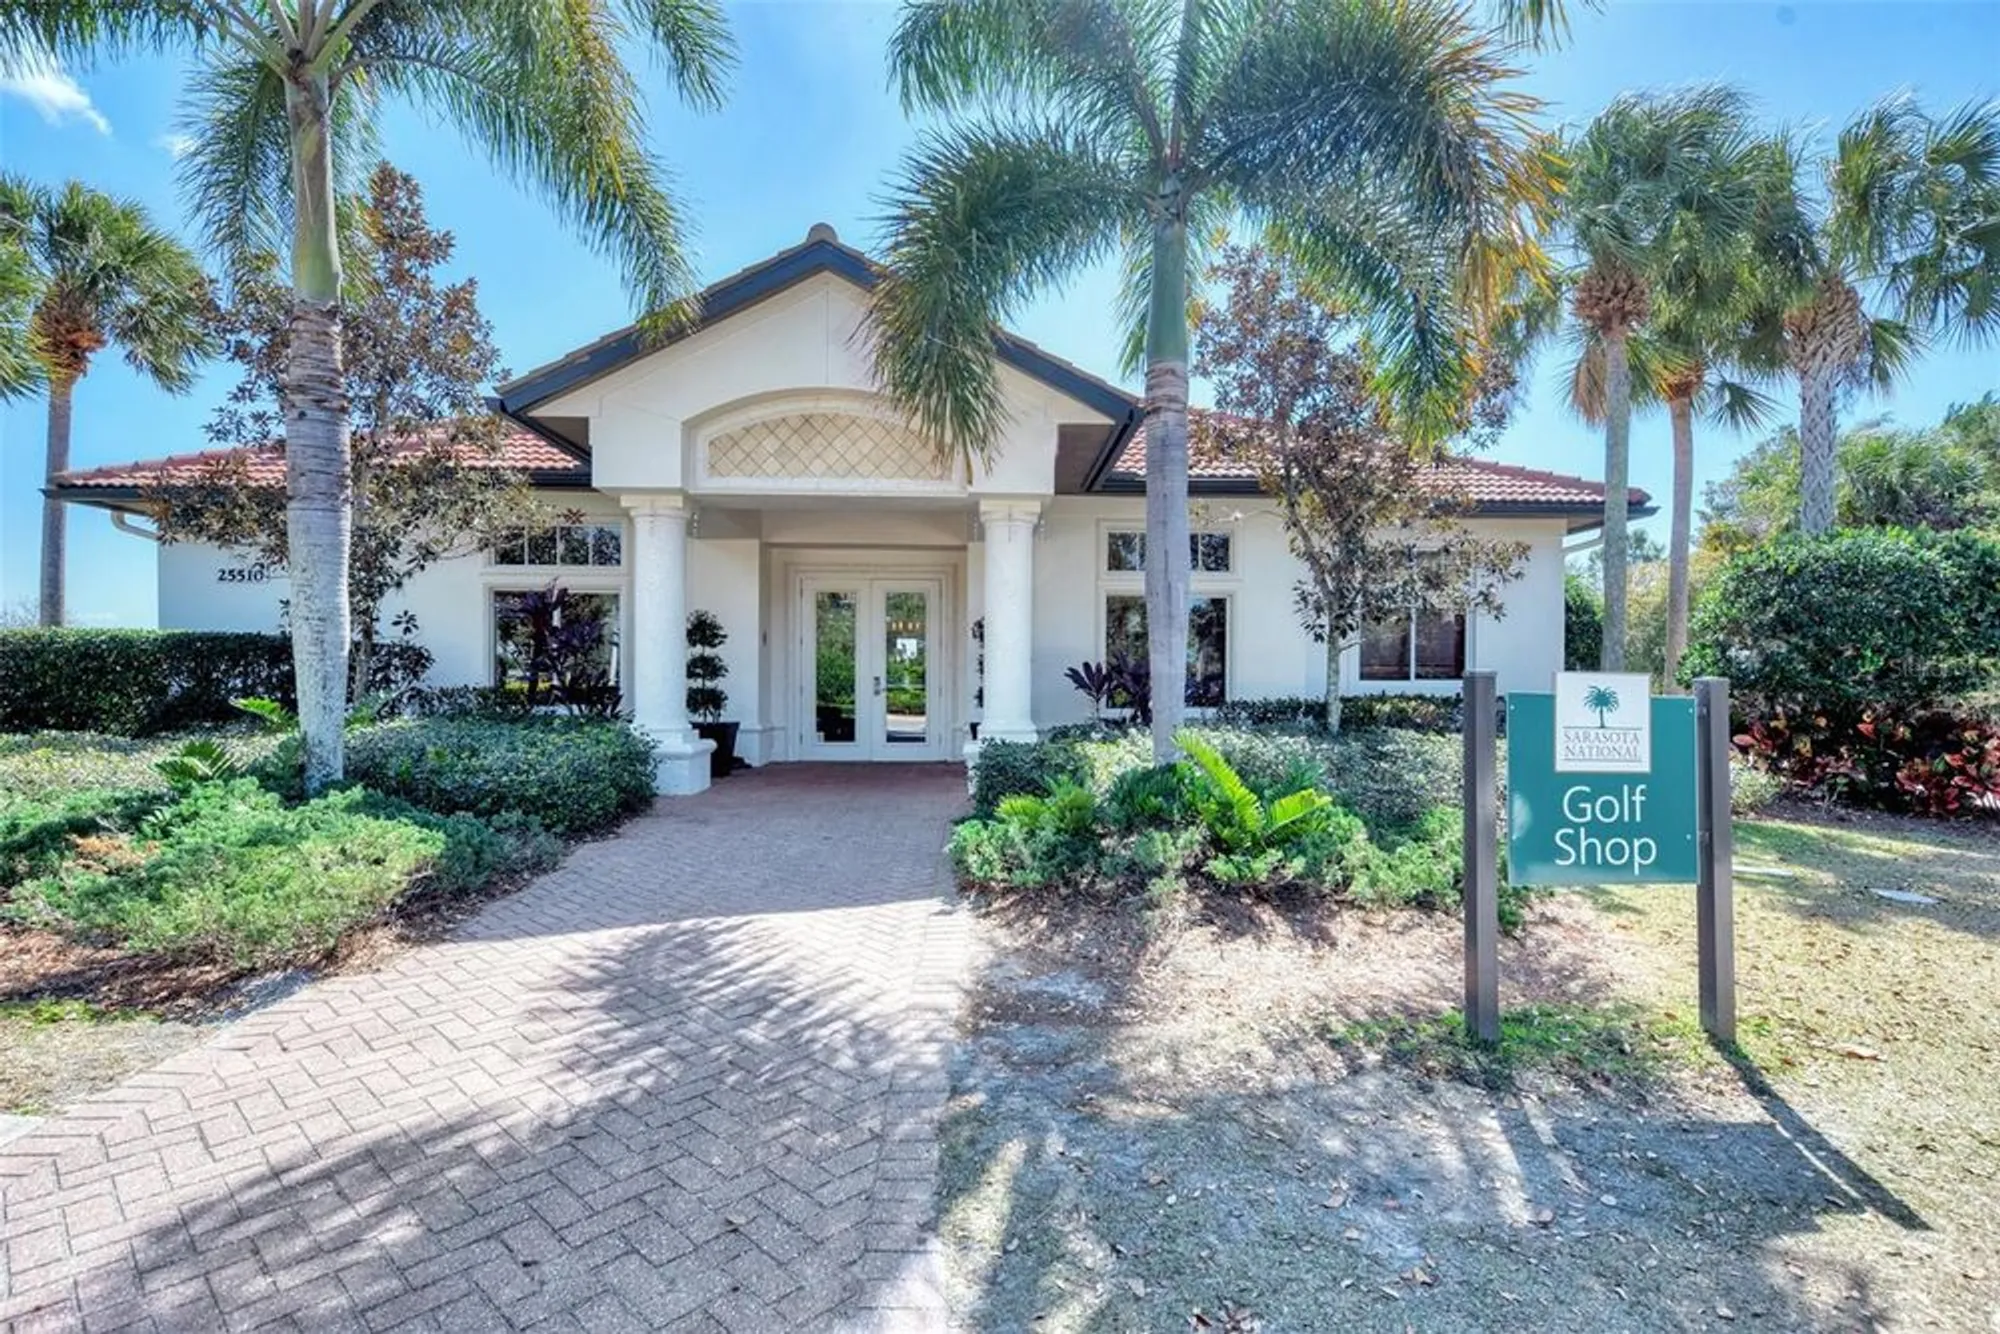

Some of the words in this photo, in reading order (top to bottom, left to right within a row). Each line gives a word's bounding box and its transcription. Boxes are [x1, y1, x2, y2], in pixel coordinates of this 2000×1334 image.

[218, 568, 264, 582] 25510
[1563, 731, 1640, 744] SARASOTA
[1563, 745, 1640, 758] NATIONAL
[1563, 784, 1647, 823] Golf
[1554, 827, 1657, 875] Shop
